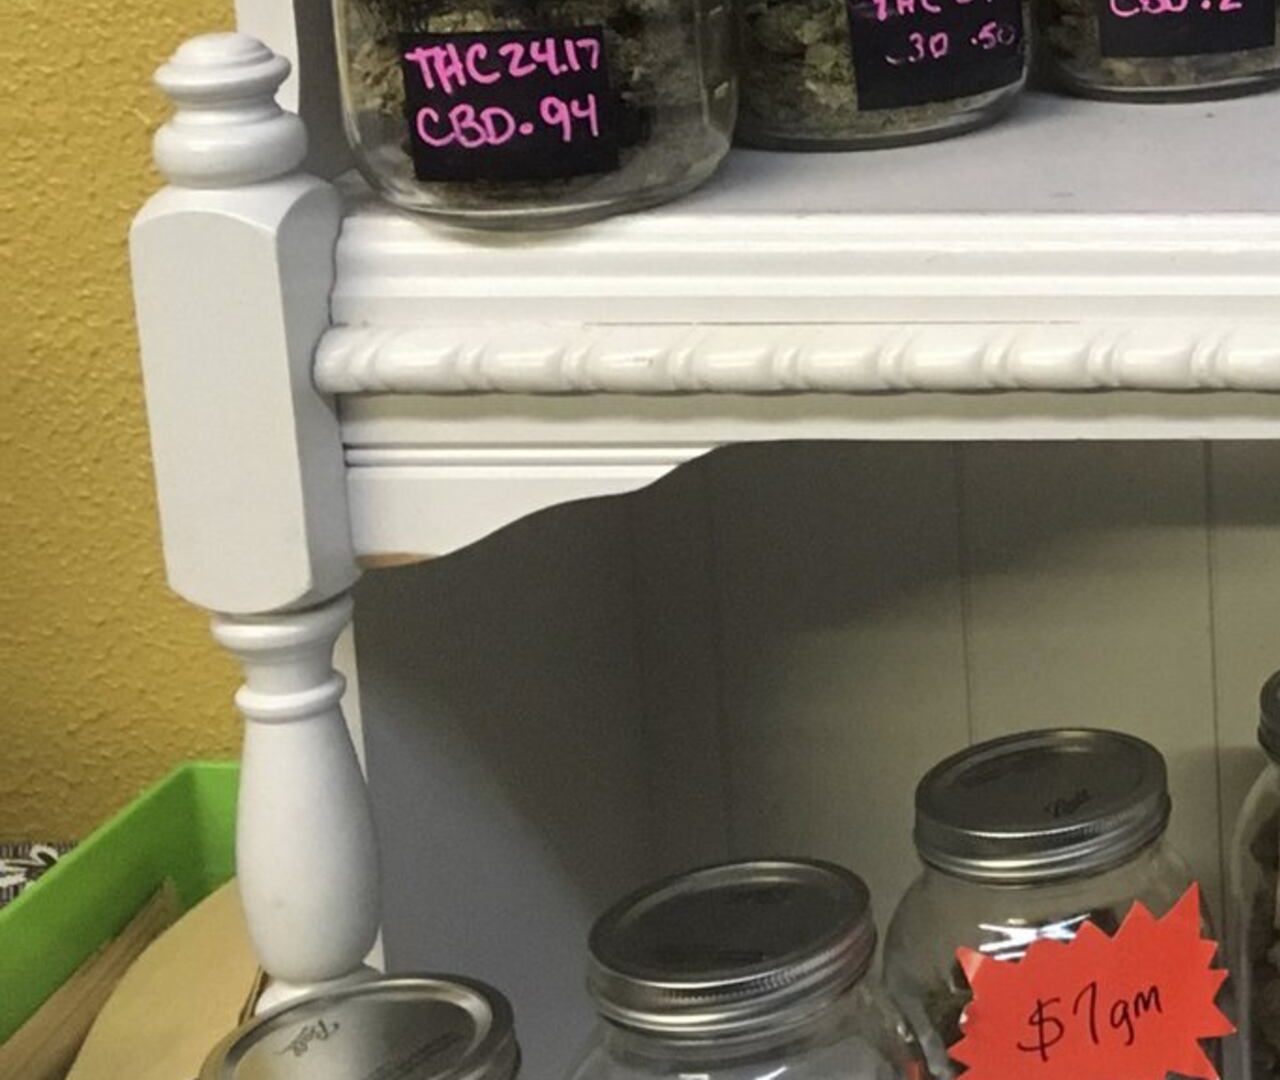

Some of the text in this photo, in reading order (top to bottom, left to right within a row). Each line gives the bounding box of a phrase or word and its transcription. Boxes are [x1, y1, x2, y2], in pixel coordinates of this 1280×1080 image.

[405, 37, 599, 95] THC 24.17
[416, 93, 600, 148] CBD .94
